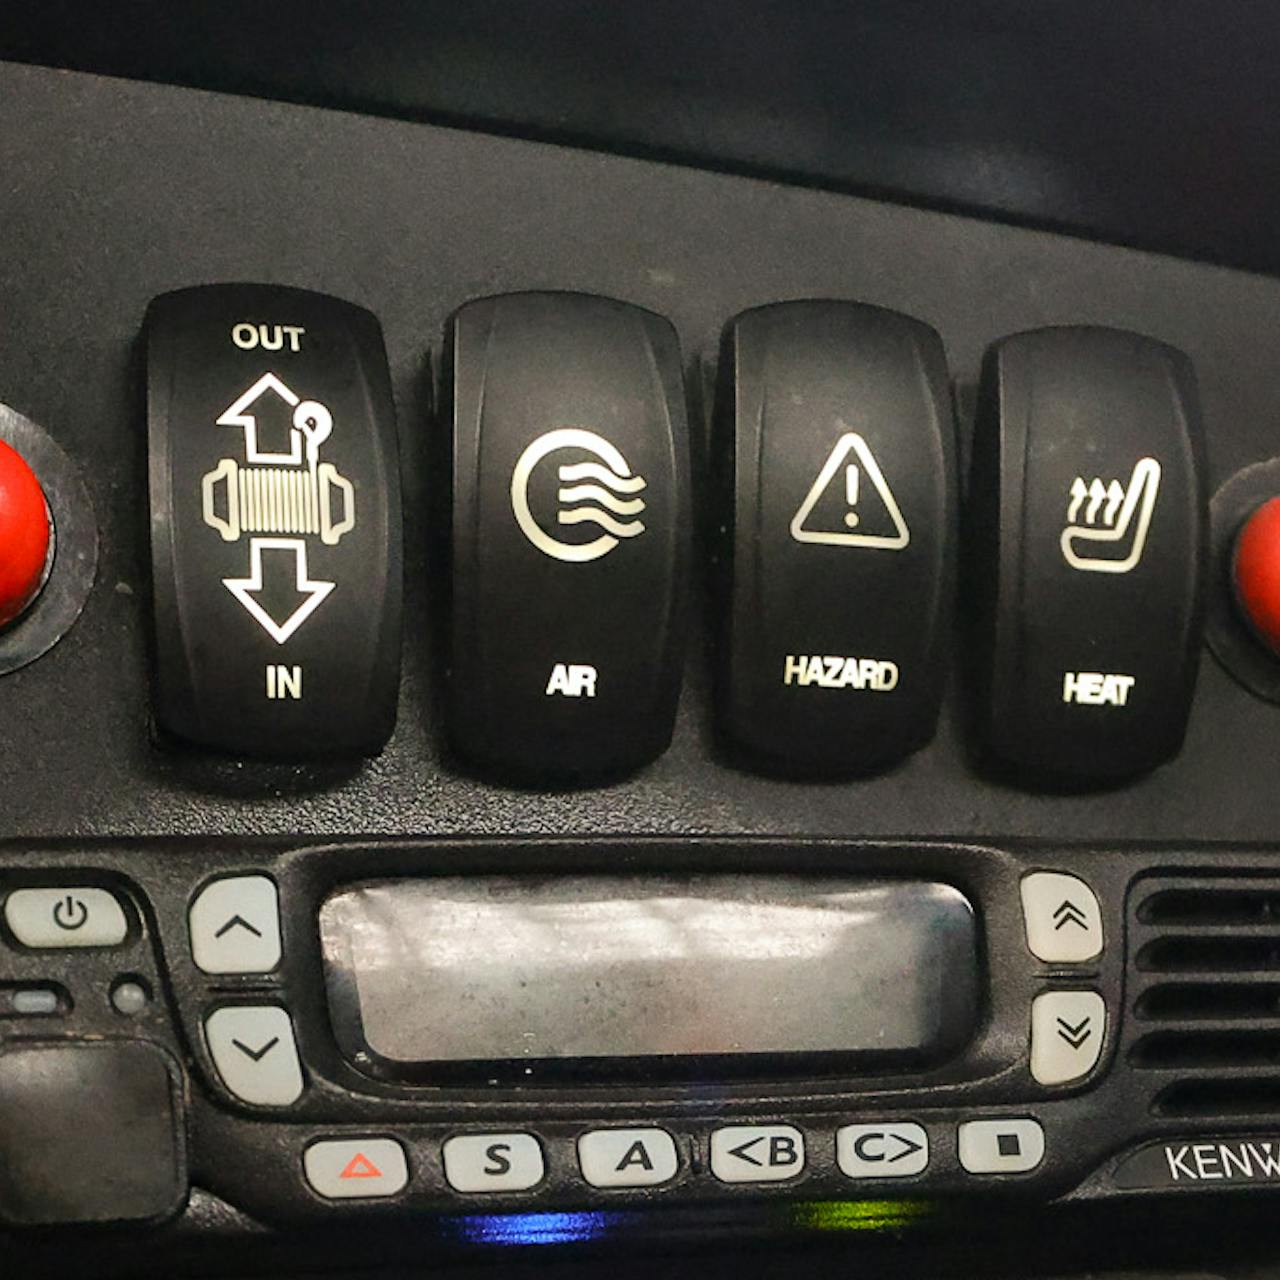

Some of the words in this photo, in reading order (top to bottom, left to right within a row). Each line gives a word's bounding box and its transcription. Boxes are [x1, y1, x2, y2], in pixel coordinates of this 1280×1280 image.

[233, 324, 304, 351] OUT
[267, 665, 301, 698] IN
[546, 664, 596, 696] AIR
[785, 656, 898, 690] HAZARD
[1064, 673, 1134, 705] HEAT
[484, 1144, 510, 1175] S
[616, 1141, 653, 1171] A
